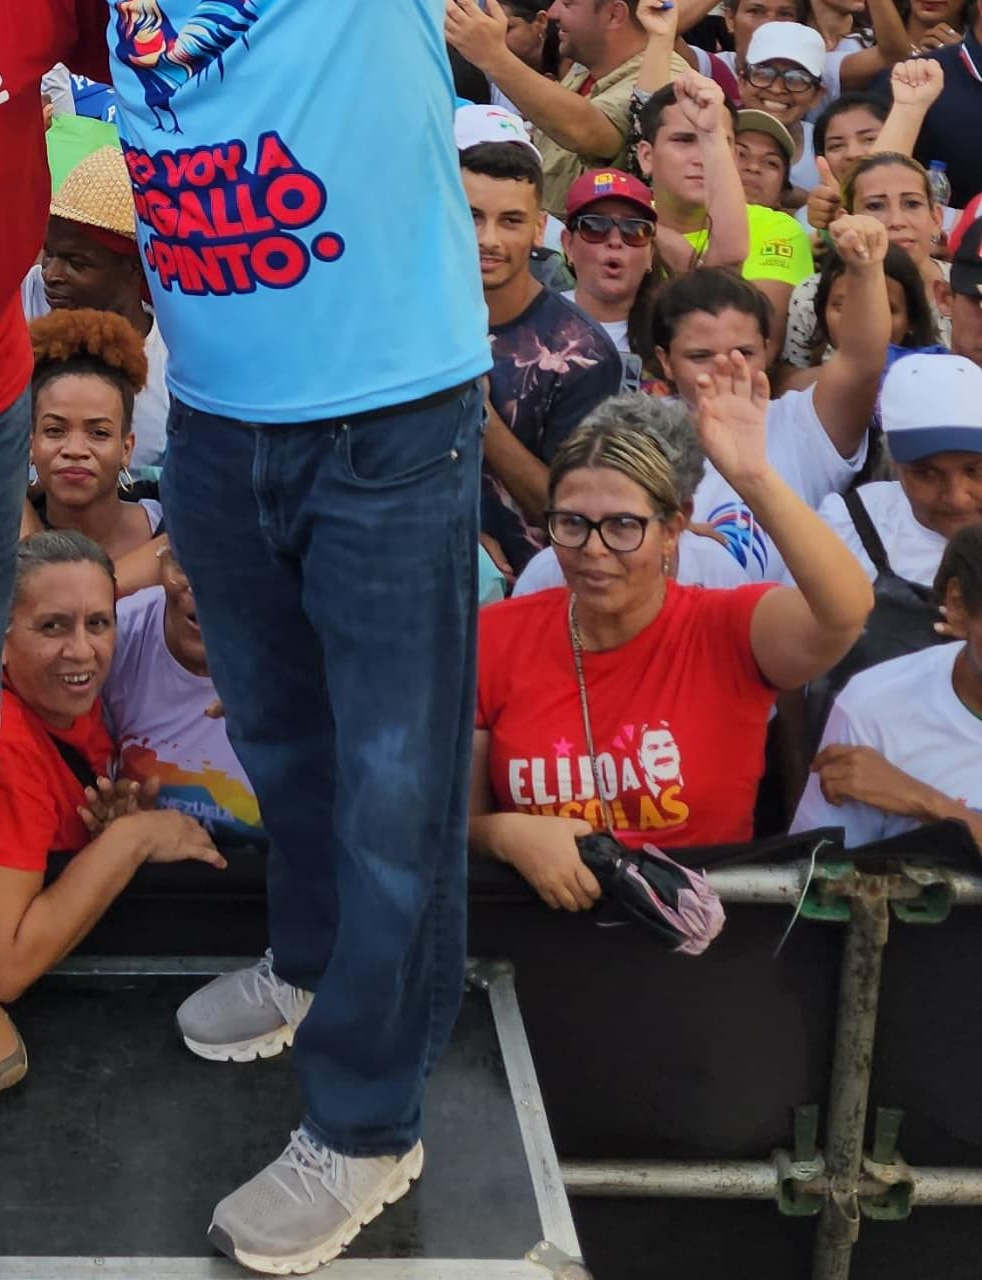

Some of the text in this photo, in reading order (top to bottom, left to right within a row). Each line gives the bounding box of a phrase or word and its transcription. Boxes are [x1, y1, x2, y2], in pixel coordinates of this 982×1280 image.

[161, 143, 244, 188] VOY
[256, 134, 294, 177] A
[508, 751, 619, 806] ELIJO
